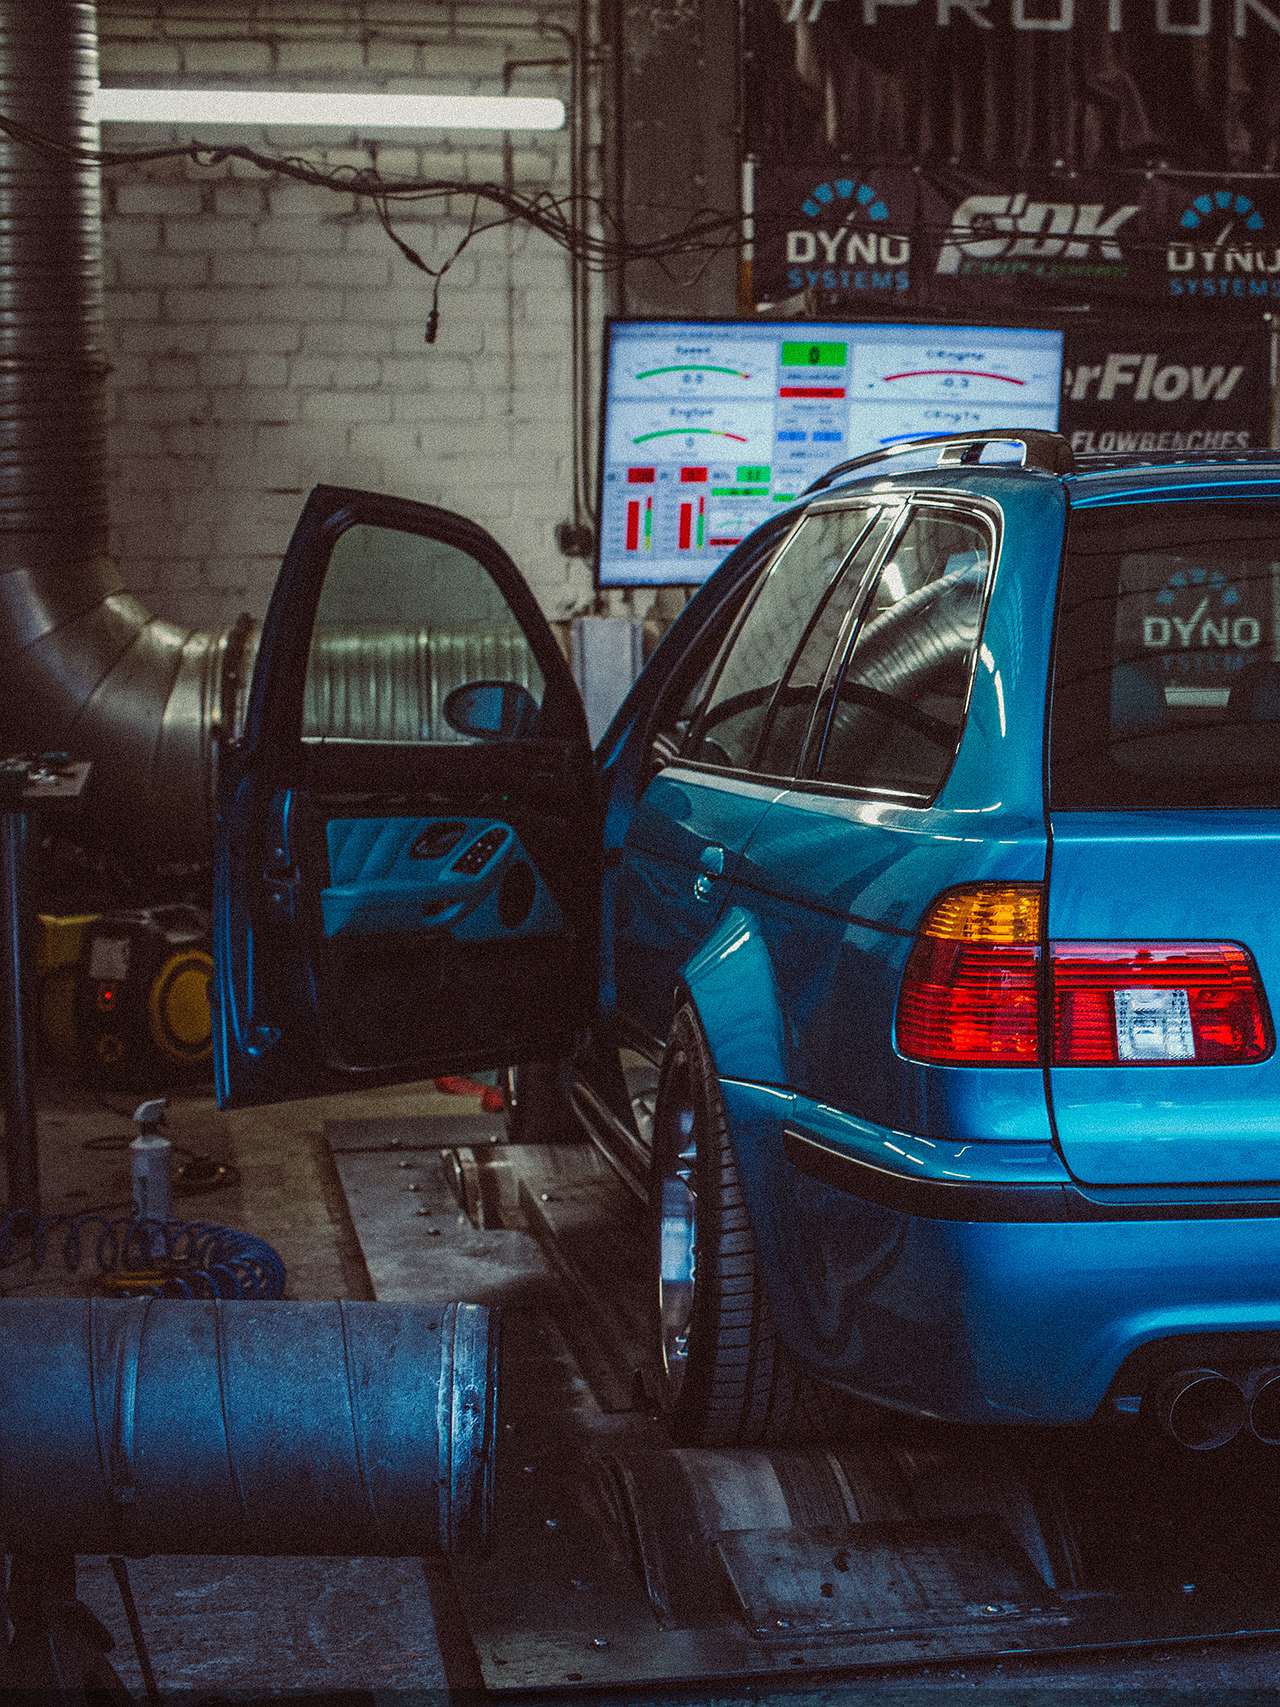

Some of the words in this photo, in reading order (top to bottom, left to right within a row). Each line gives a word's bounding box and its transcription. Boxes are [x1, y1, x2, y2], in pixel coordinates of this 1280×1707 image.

[787, 227, 911, 265] DYNO
[788, 269, 911, 290] SYSTEMS
[1143, 615, 1261, 648] DYNO
